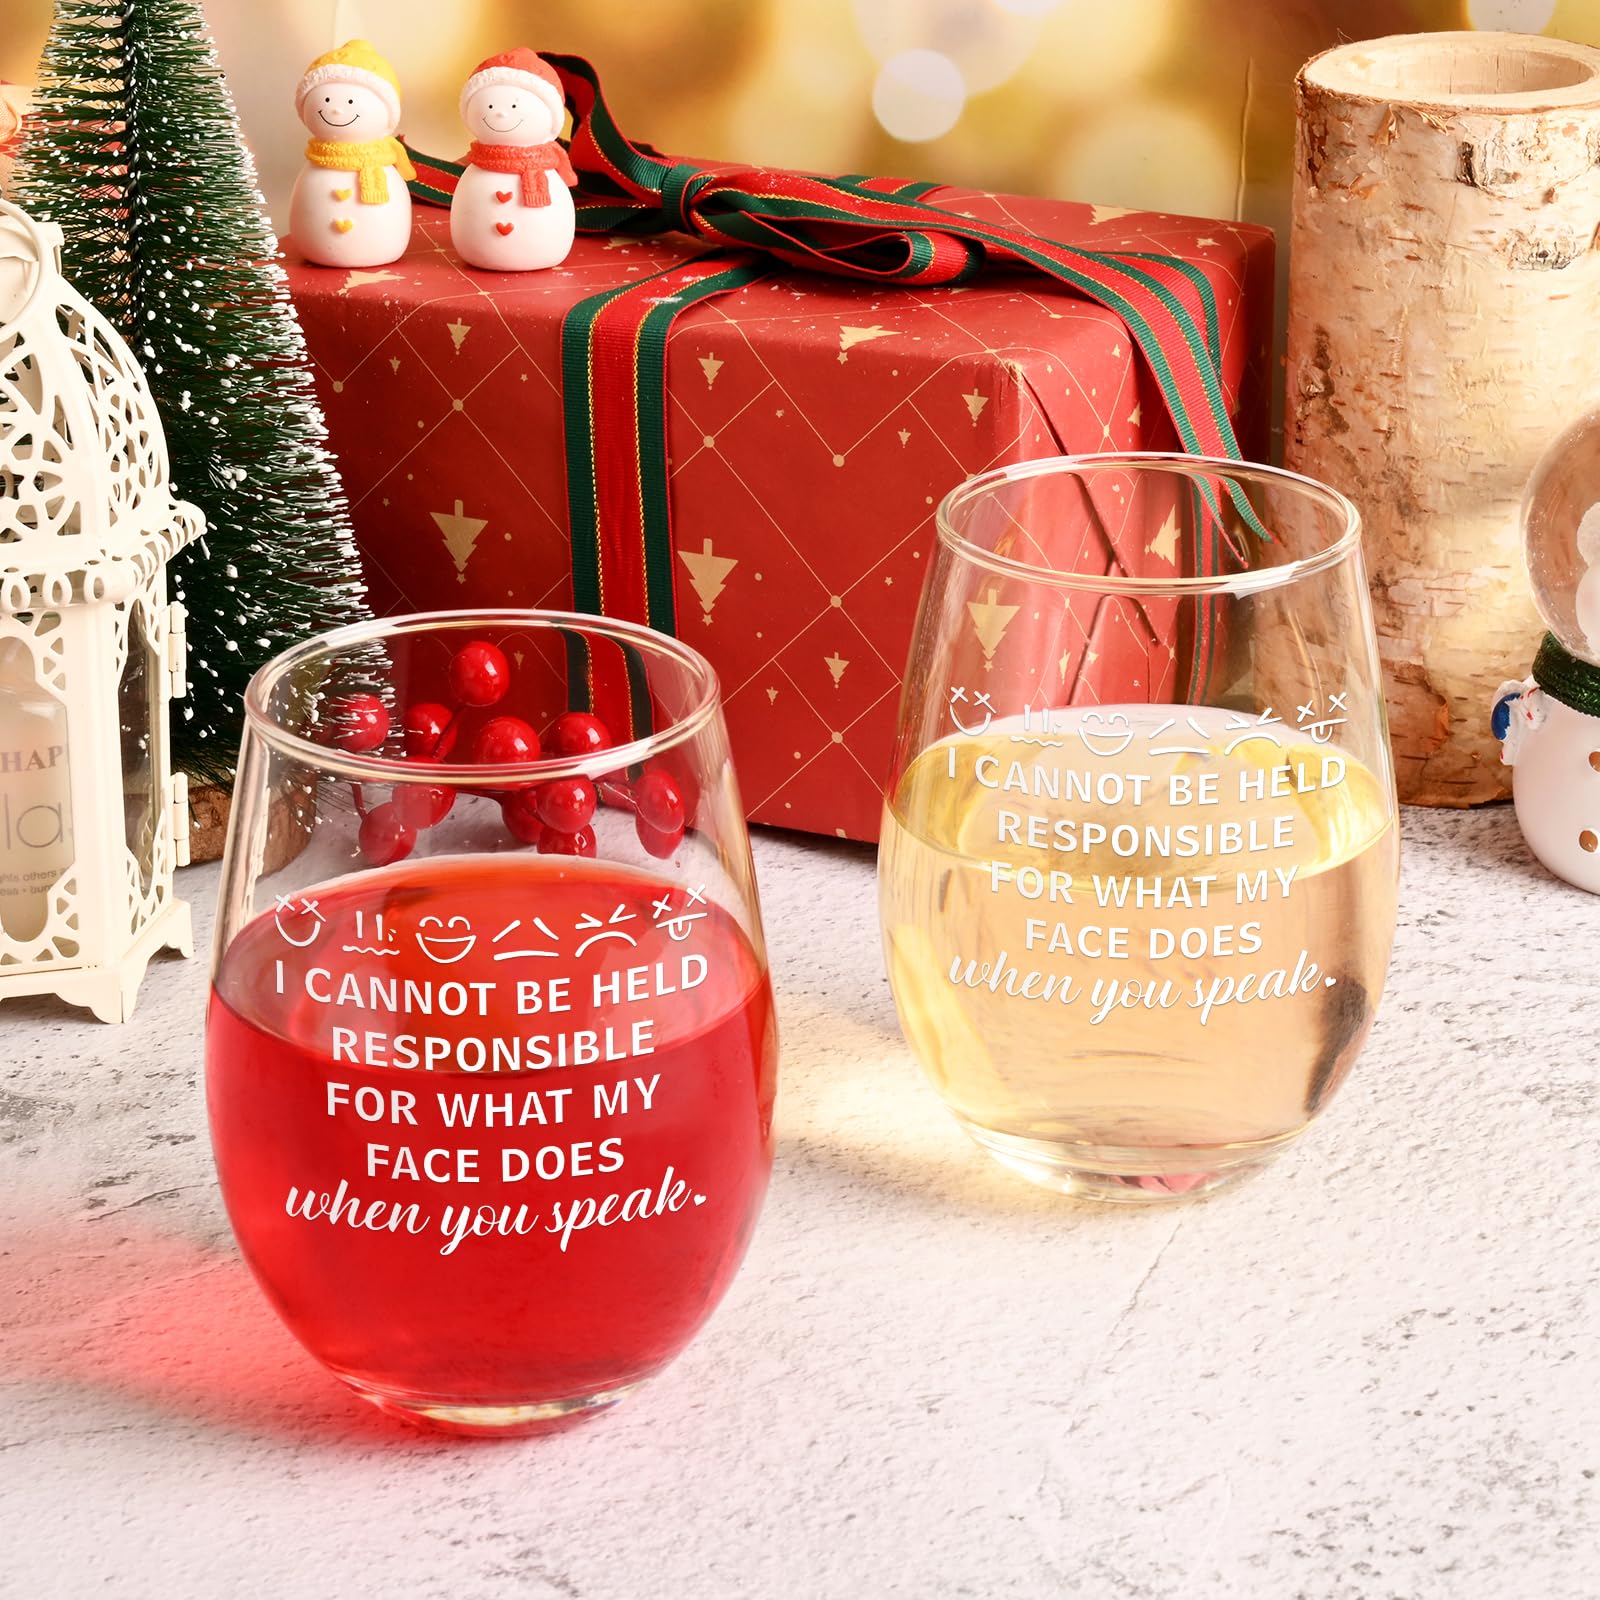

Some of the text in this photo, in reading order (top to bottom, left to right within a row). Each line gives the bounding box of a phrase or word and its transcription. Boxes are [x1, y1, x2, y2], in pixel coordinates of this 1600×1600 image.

[947, 747, 1347, 806] I CANNOT BE HELD
[998, 809, 1296, 858] RESPONSIBLE
[990, 860, 1300, 909] FOR WHAT MY
[1025, 918, 1263, 960] FACE DOES
[275, 953, 708, 1016] I CANNOT BE HELD
[948, 951, 1082, 1005] when
[1089, 976, 1182, 1026] you
[332, 1019, 655, 1073] RESPONSIBLE
[327, 1073, 661, 1128] FOR WHAT MY
[367, 1137, 624, 1183] FACE DOES
[284, 1179, 431, 1234] when
[439, 1203, 540, 1256] you
